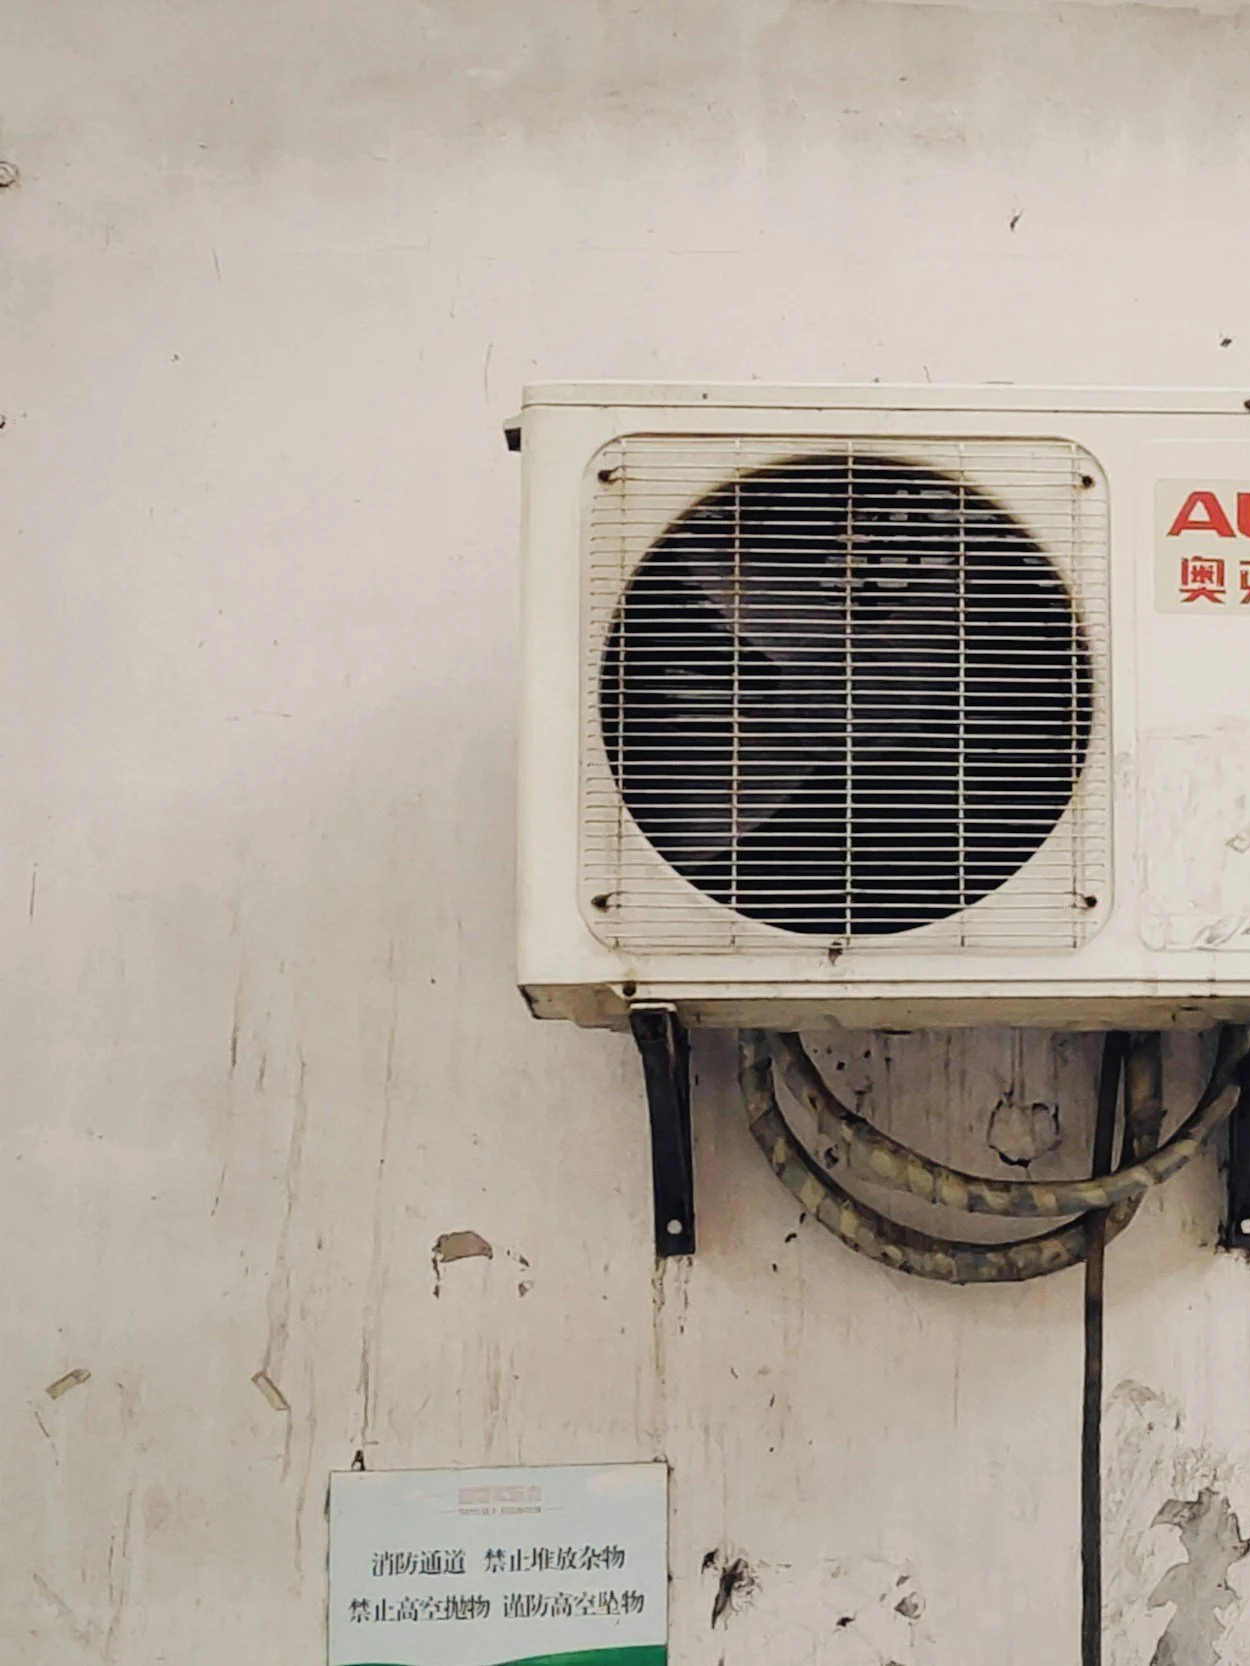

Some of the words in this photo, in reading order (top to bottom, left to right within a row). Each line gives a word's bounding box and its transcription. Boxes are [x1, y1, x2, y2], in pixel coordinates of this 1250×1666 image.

[372, 1549, 466, 1577] 消防通道
[485, 1545, 625, 1573] 禁止堆放杂物
[348, 1595, 491, 1622] 禁止高空抛物
[502, 1591, 645, 1619] 谨防高空坠物
